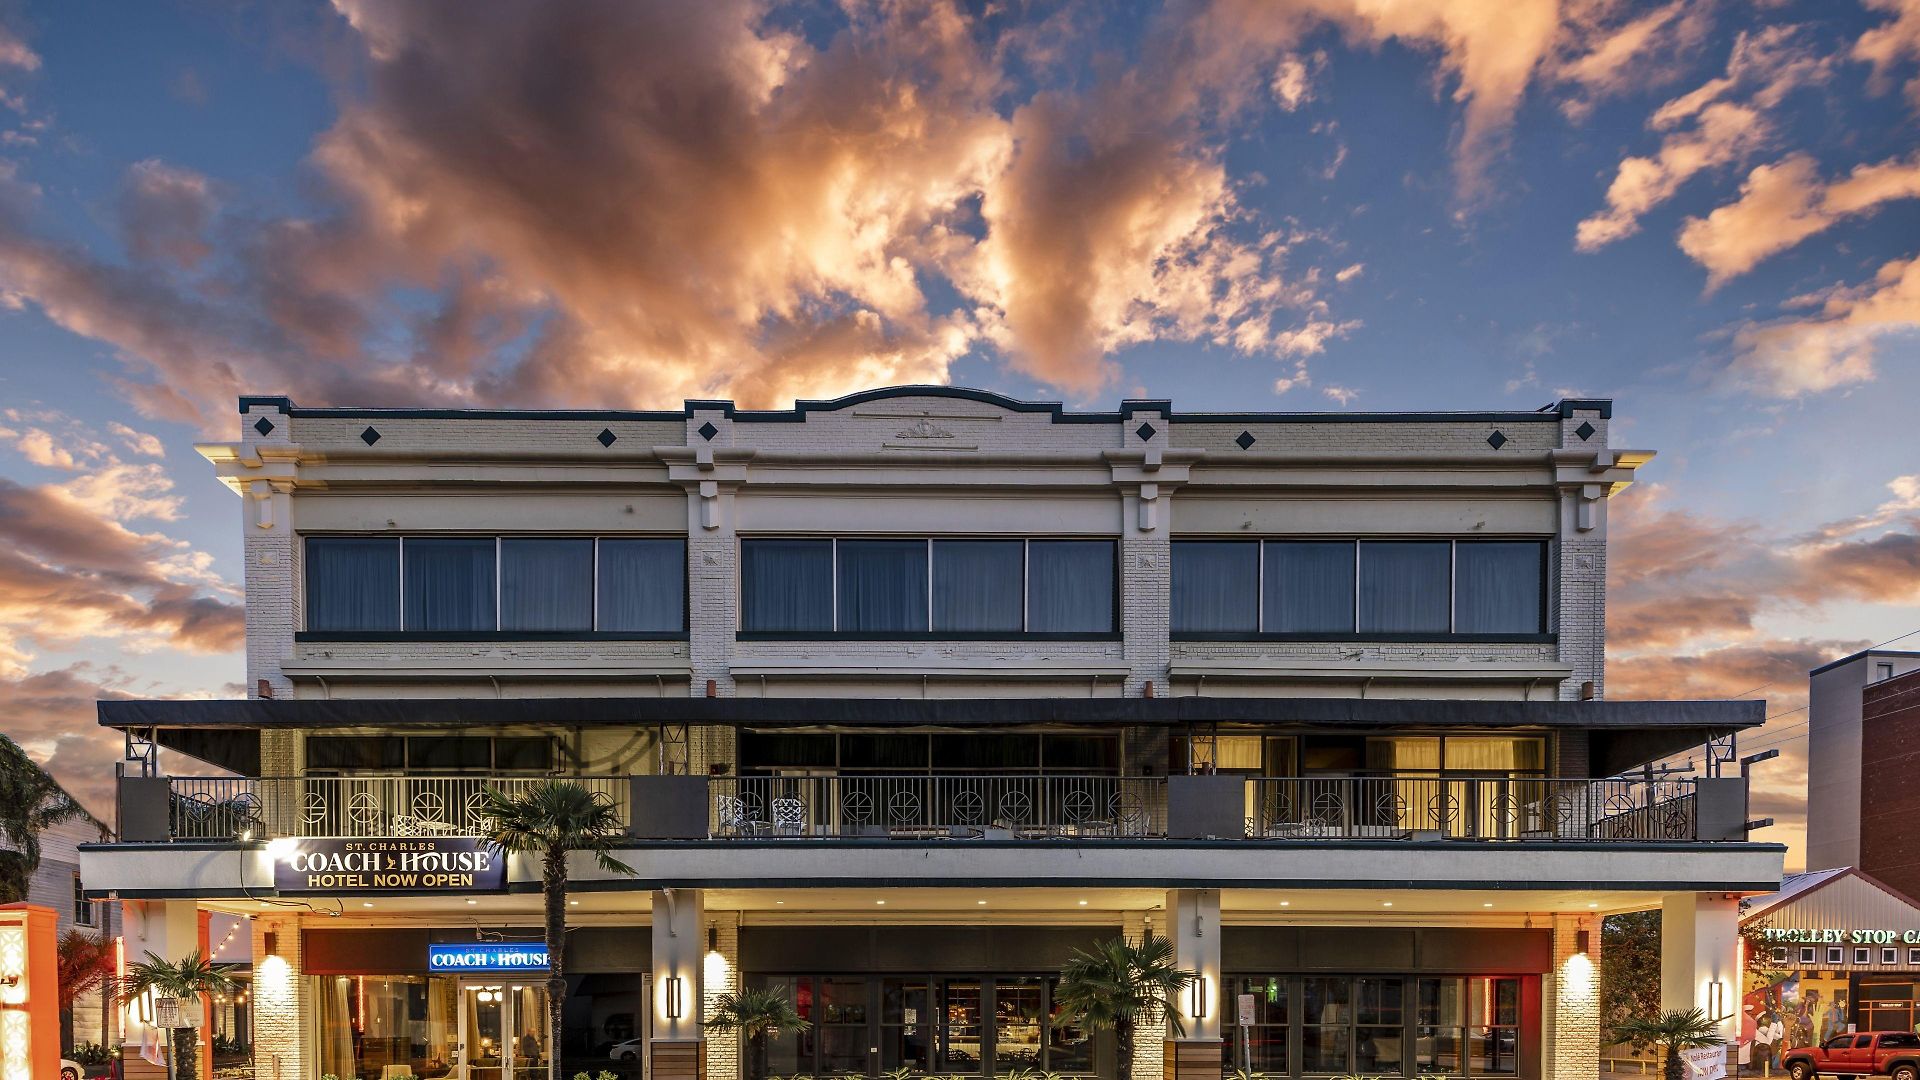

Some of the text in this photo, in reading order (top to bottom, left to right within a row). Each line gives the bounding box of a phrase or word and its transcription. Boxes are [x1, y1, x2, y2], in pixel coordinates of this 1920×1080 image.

[345, 842, 435, 851] ST. CHARLES
[290, 851, 490, 872] COACH HOUSE
[308, 873, 473, 887] HOTEL NOW OPEN
[1763, 928, 1846, 943] TROLLEY
[1851, 929, 1897, 944] STOP
[431, 953, 487, 966] COACH
